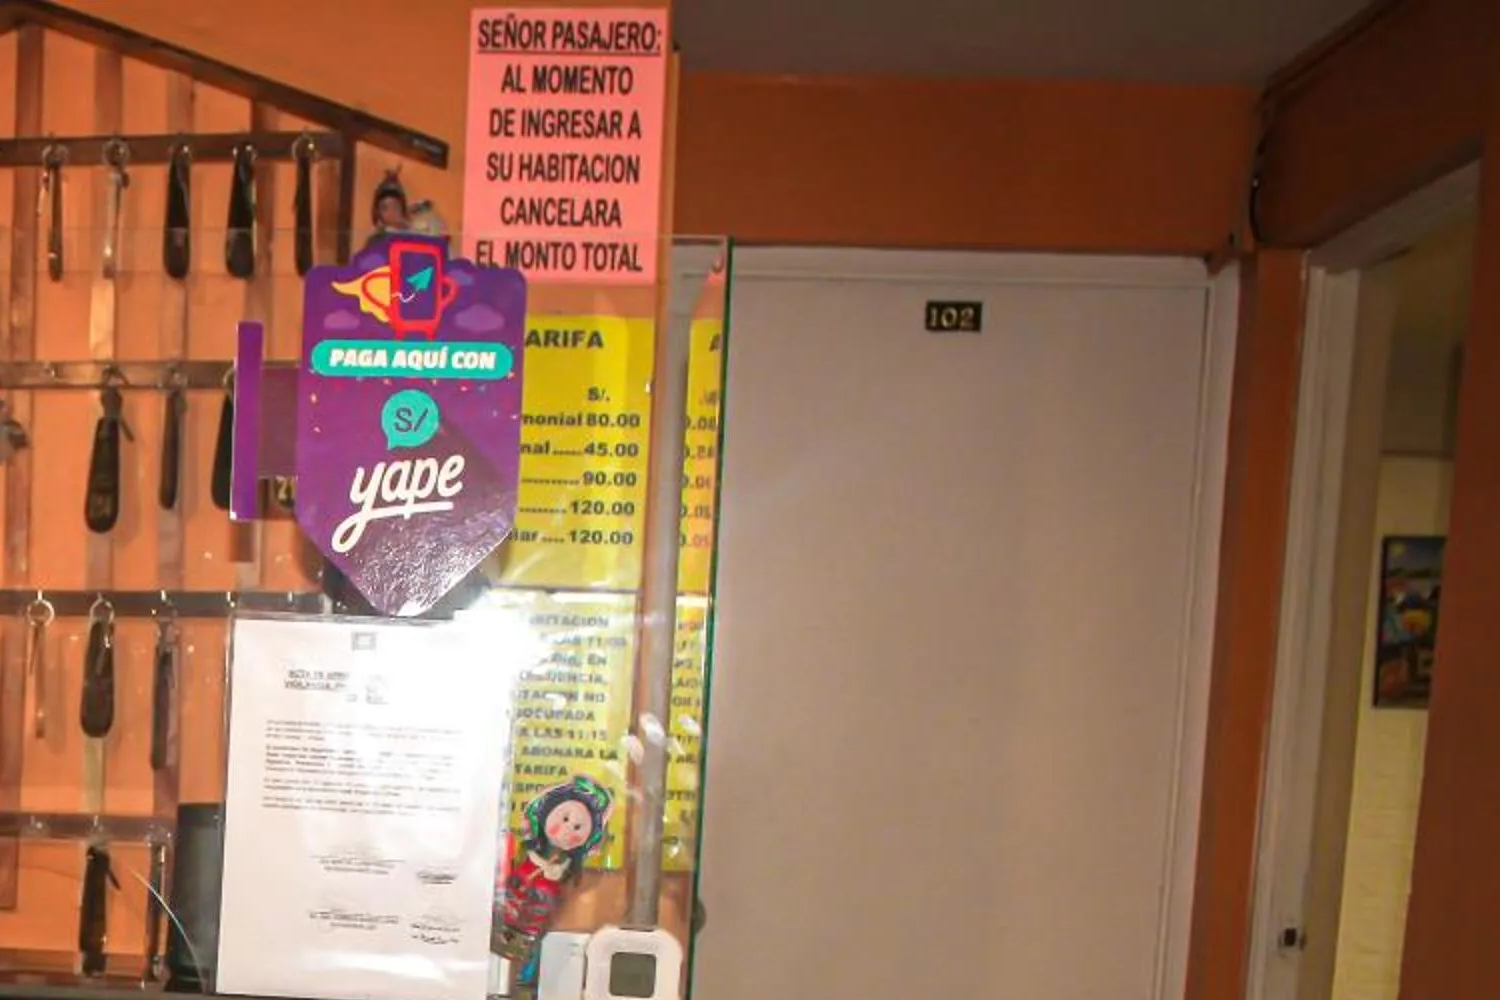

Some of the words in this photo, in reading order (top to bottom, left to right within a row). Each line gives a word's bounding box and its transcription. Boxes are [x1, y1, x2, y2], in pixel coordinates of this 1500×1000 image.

[477, 13, 546, 49] SEÑOR
[551, 20, 661, 51] PASAJERO:
[501, 64, 526, 93] AL
[532, 64, 633, 95] MOMENTO
[489, 108, 516, 137] DE
[521, 108, 623, 139] INGRESAR
[627, 111, 642, 139] A
[486, 152, 513, 181] SU
[519, 153, 640, 183] HABITACION
[501, 197, 622, 227] CANCELARA
[476, 240, 498, 267] EL
[505, 242, 576, 271] MONTO
[582, 243, 643, 272] TOTAL
[930, 306, 975, 328] 102
[329, 348, 388, 368] PAGA
[392, 346, 448, 370] AQUÍ
[451, 351, 496, 371] CON
[394, 407, 429, 433] S/
[586, 412, 640, 428] 80.00
[583, 442, 639, 458] 45.00
[582, 471, 636, 487] 90.00
[331, 454, 466, 552] yape
[570, 501, 635, 516] 120.00
[569, 530, 633, 544] 120.00
[515, 764, 568, 776] TARIFA
